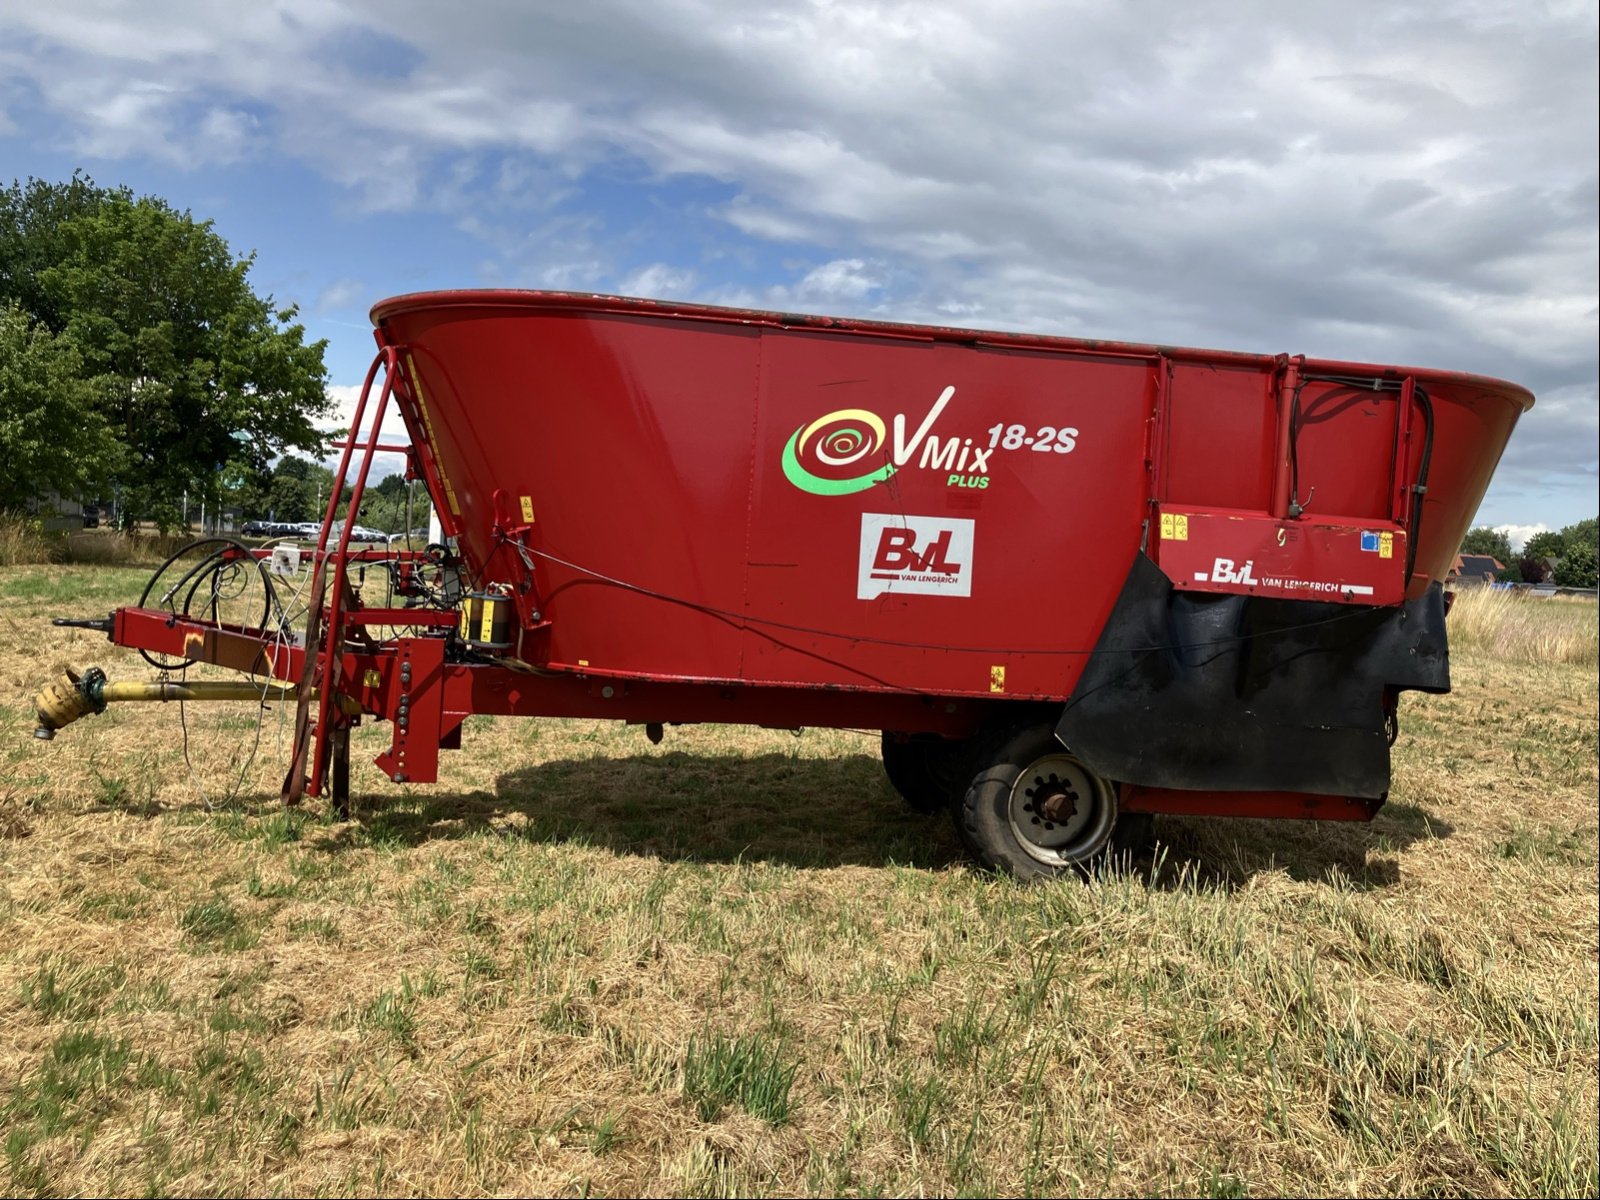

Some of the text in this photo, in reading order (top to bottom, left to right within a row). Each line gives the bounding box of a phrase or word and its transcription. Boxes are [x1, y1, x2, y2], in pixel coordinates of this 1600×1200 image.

[893, 385, 1079, 473] VMix 18-2S
[947, 474, 990, 489] PLUS
[901, 574, 958, 584] VAN LENGERICH
[1262, 577, 1282, 588] VAN
